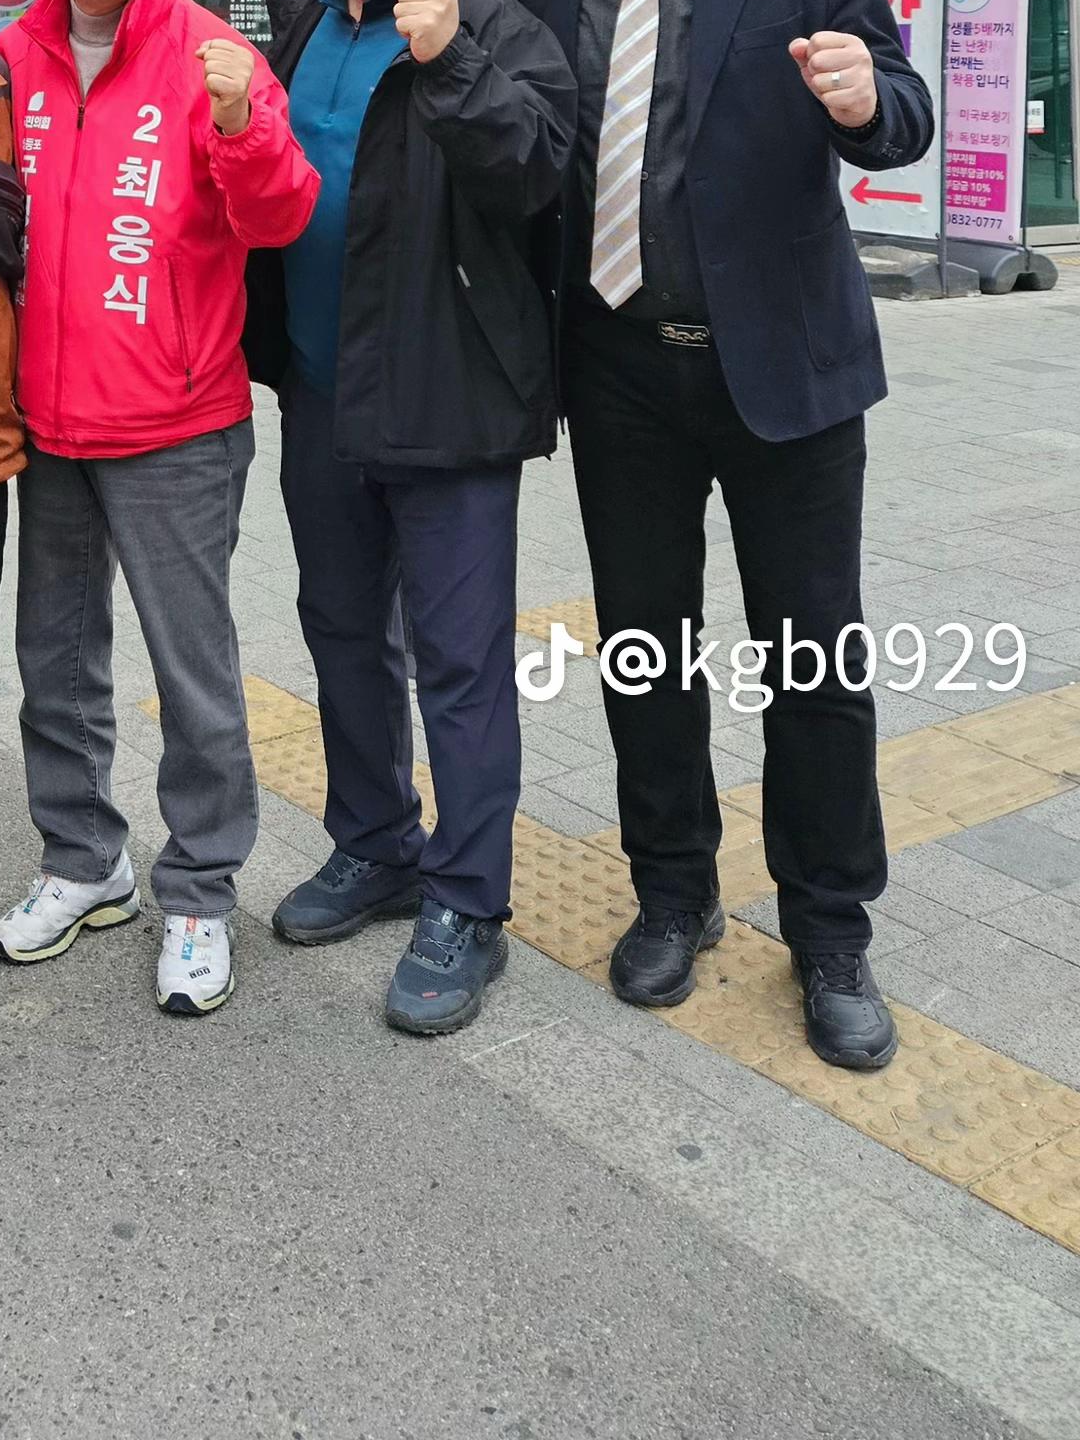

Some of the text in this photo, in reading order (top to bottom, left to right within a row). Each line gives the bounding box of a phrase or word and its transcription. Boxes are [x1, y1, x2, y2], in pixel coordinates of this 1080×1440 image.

[949, 21, 1015, 37] 생률5배까지
[23, 115, 52, 131] 민의힘
[103, 104, 162, 325] 2 최웅식
